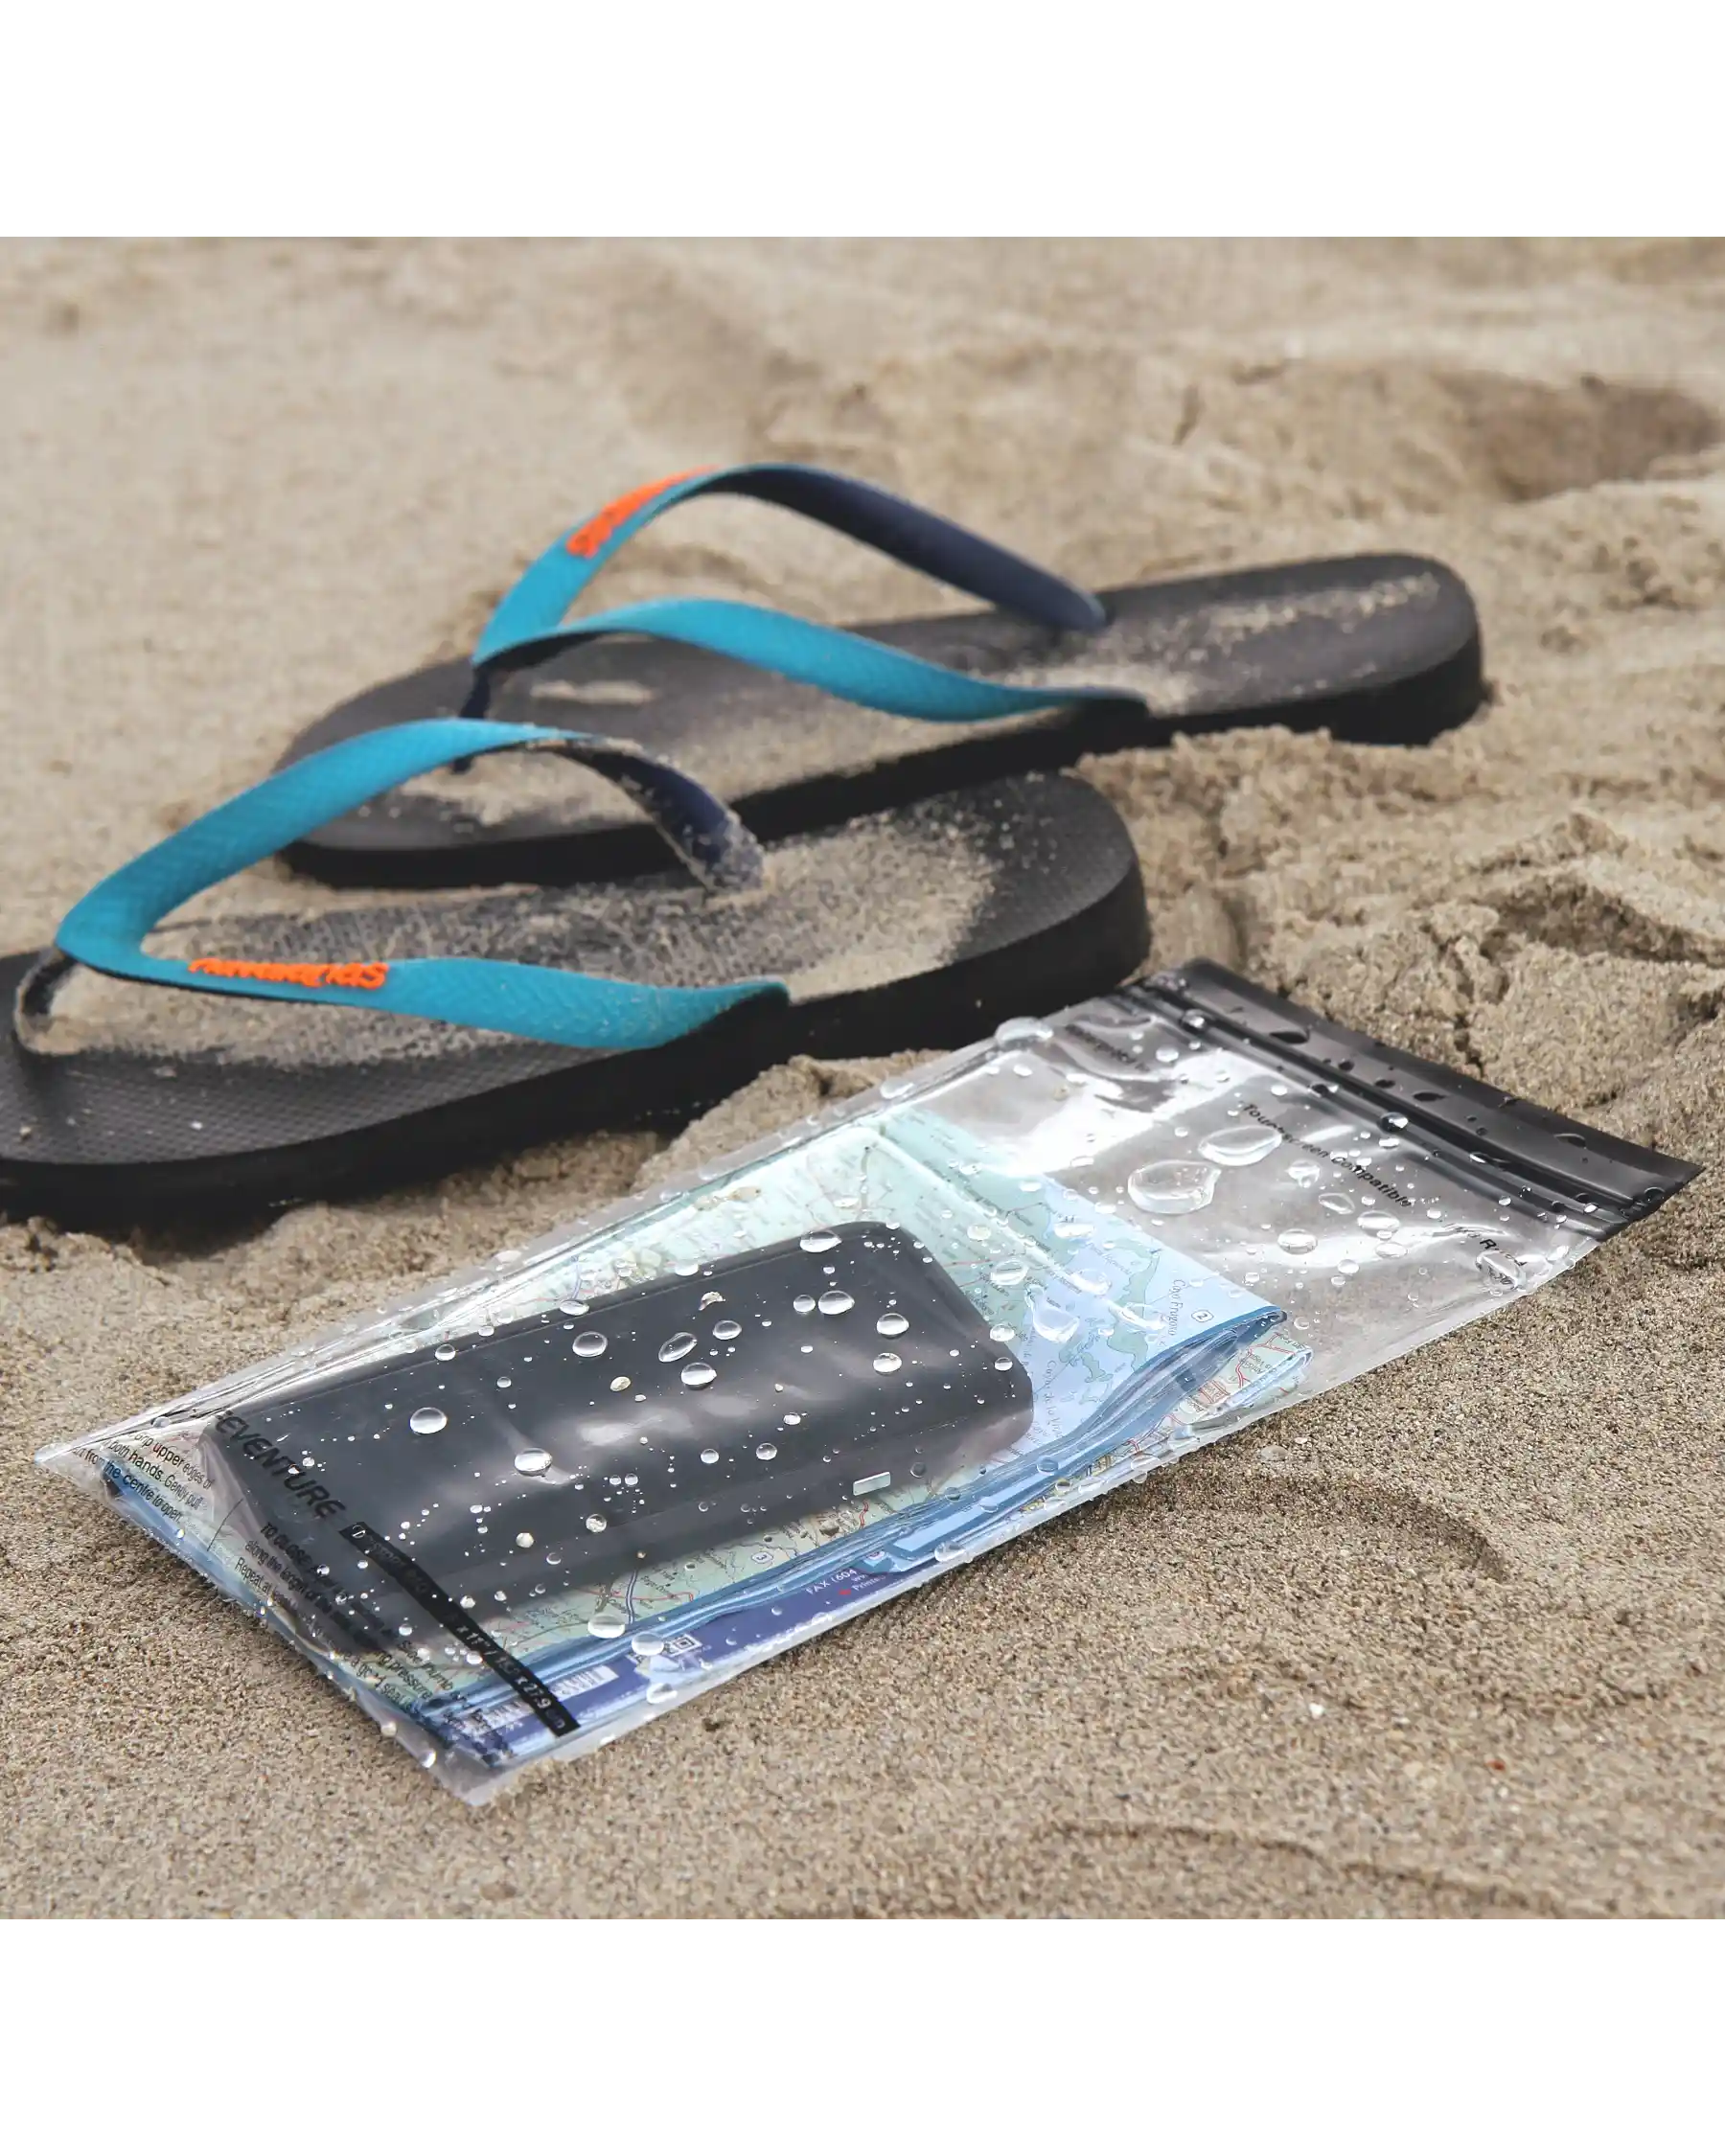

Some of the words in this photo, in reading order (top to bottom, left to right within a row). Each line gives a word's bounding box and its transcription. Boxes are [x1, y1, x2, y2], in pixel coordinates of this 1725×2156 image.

[1330, 1155, 1413, 1209] Compatible
[103, 1459, 122, 1479] the
[123, 1473, 156, 1502] centre
[127, 1450, 163, 1482] hands.
[152, 1443, 185, 1468] upper
[182, 1462, 205, 1484] edges
[213, 1409, 346, 1519] EVENTURE
[805, 1579, 832, 1595] FAX
